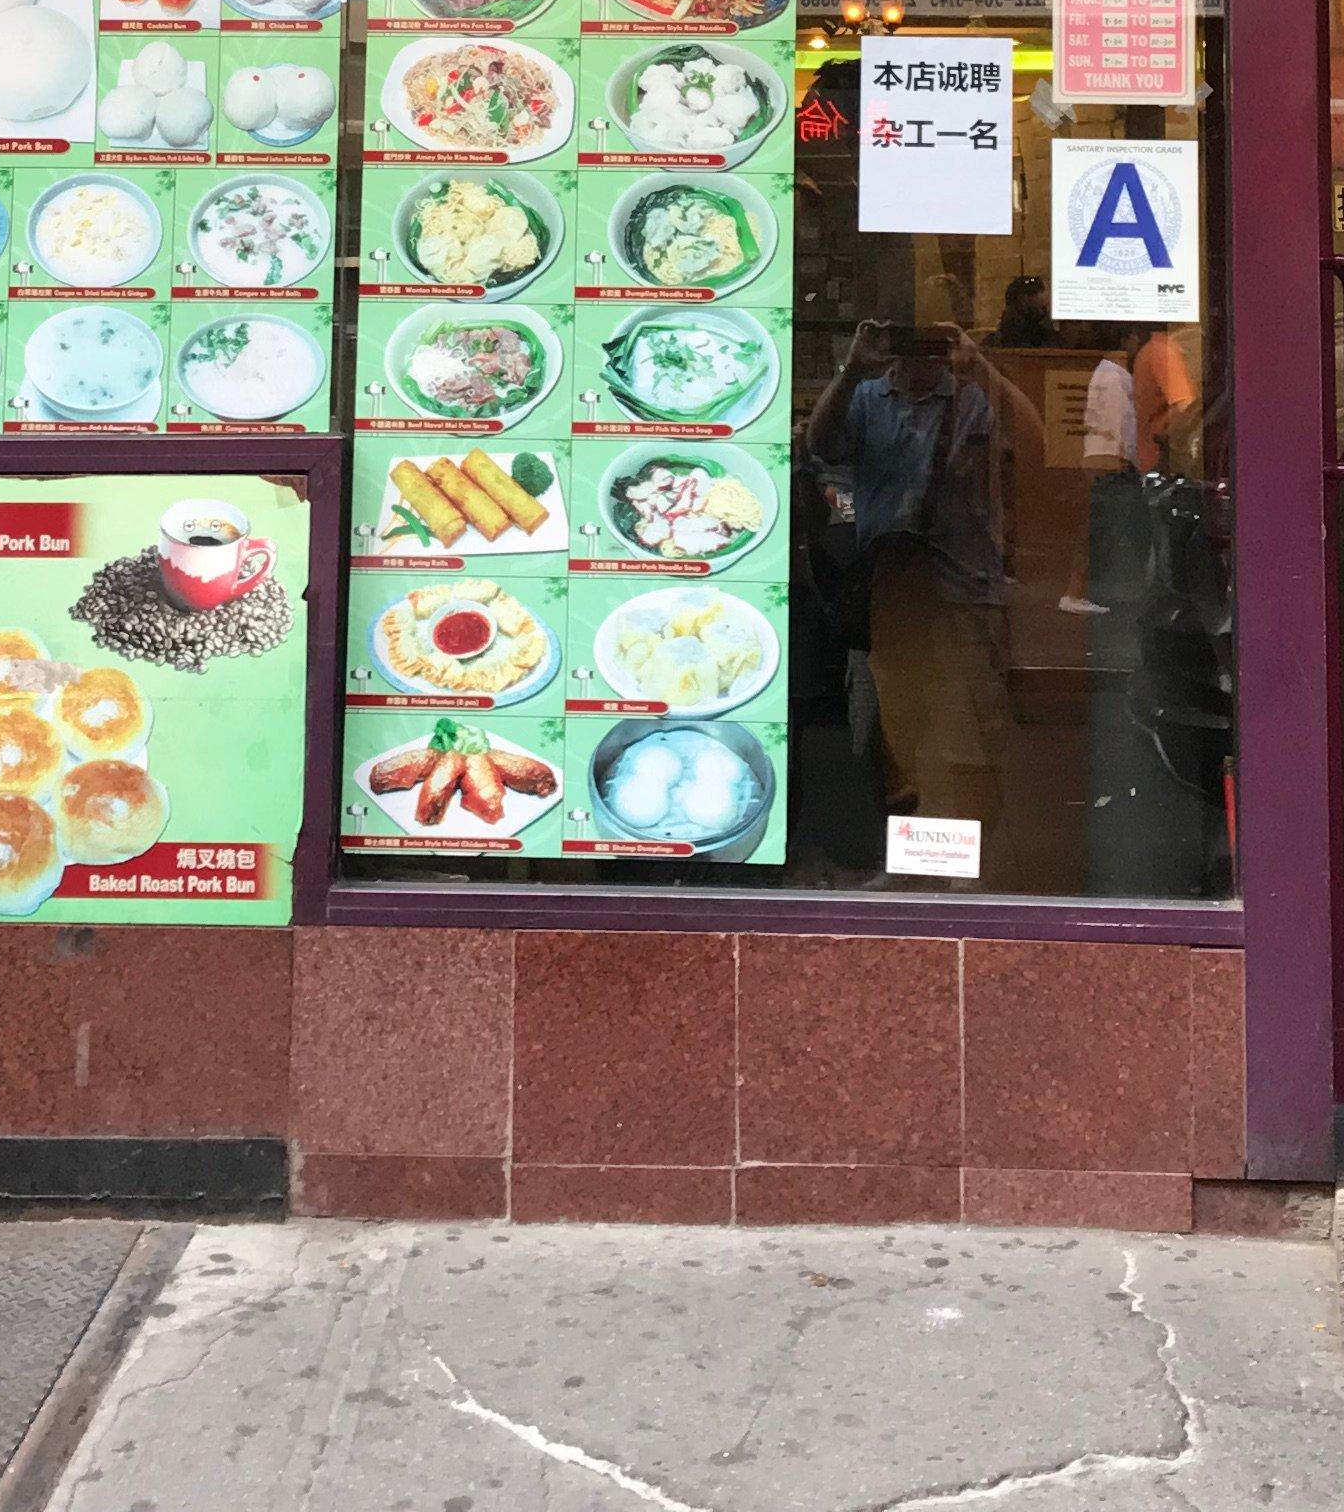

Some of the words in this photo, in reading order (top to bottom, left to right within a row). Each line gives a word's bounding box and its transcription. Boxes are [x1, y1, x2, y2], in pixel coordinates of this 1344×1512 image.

[1130, 14, 1147, 26] TO
[1130, 35, 1147, 47] TO
[1130, 55, 1147, 67] TO
[873, 61, 1002, 94] 本店诚聘
[1084, 73, 1131, 88] THANK
[1135, 73, 1164, 88] YOU
[871, 118, 999, 151] 杂工一名
[12, 142, 32, 150] Pork
[35, 142, 52, 150] Bun
[1067, 145, 1104, 153] SANITARY
[1107, 145, 1153, 153] INSPECTION
[1155, 146, 1182, 154] GRADE
[1076, 163, 1174, 268] A
[1157, 284, 1185, 293] NYC
[39, 534, 70, 552] Bun
[89, 874, 137, 892] Baked
[140, 875, 184, 893] Roast
[187, 875, 223, 893] Pork
[226, 875, 256, 893] Bun
